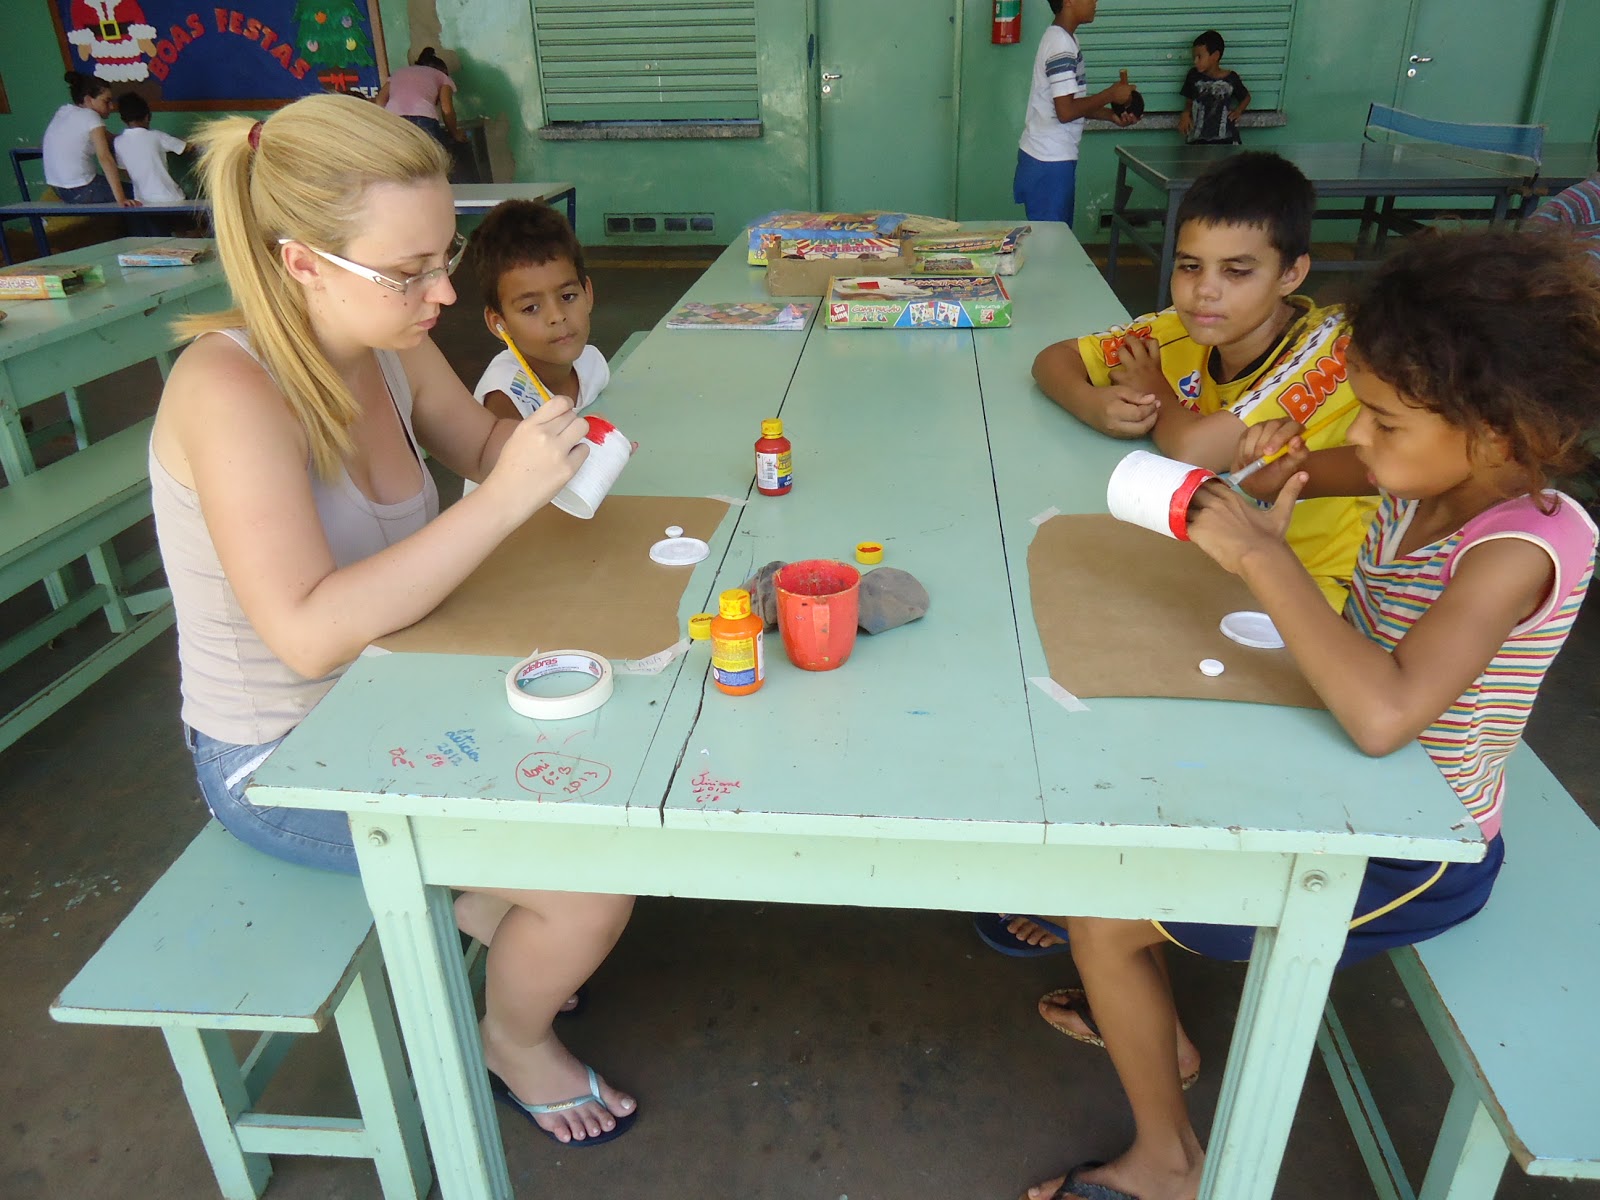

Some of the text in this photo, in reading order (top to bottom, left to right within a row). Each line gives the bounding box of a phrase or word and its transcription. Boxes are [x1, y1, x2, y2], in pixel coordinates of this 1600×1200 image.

[147, 7, 312, 81] BOAS FESTAS
[522, 657, 558, 677] adelbras
